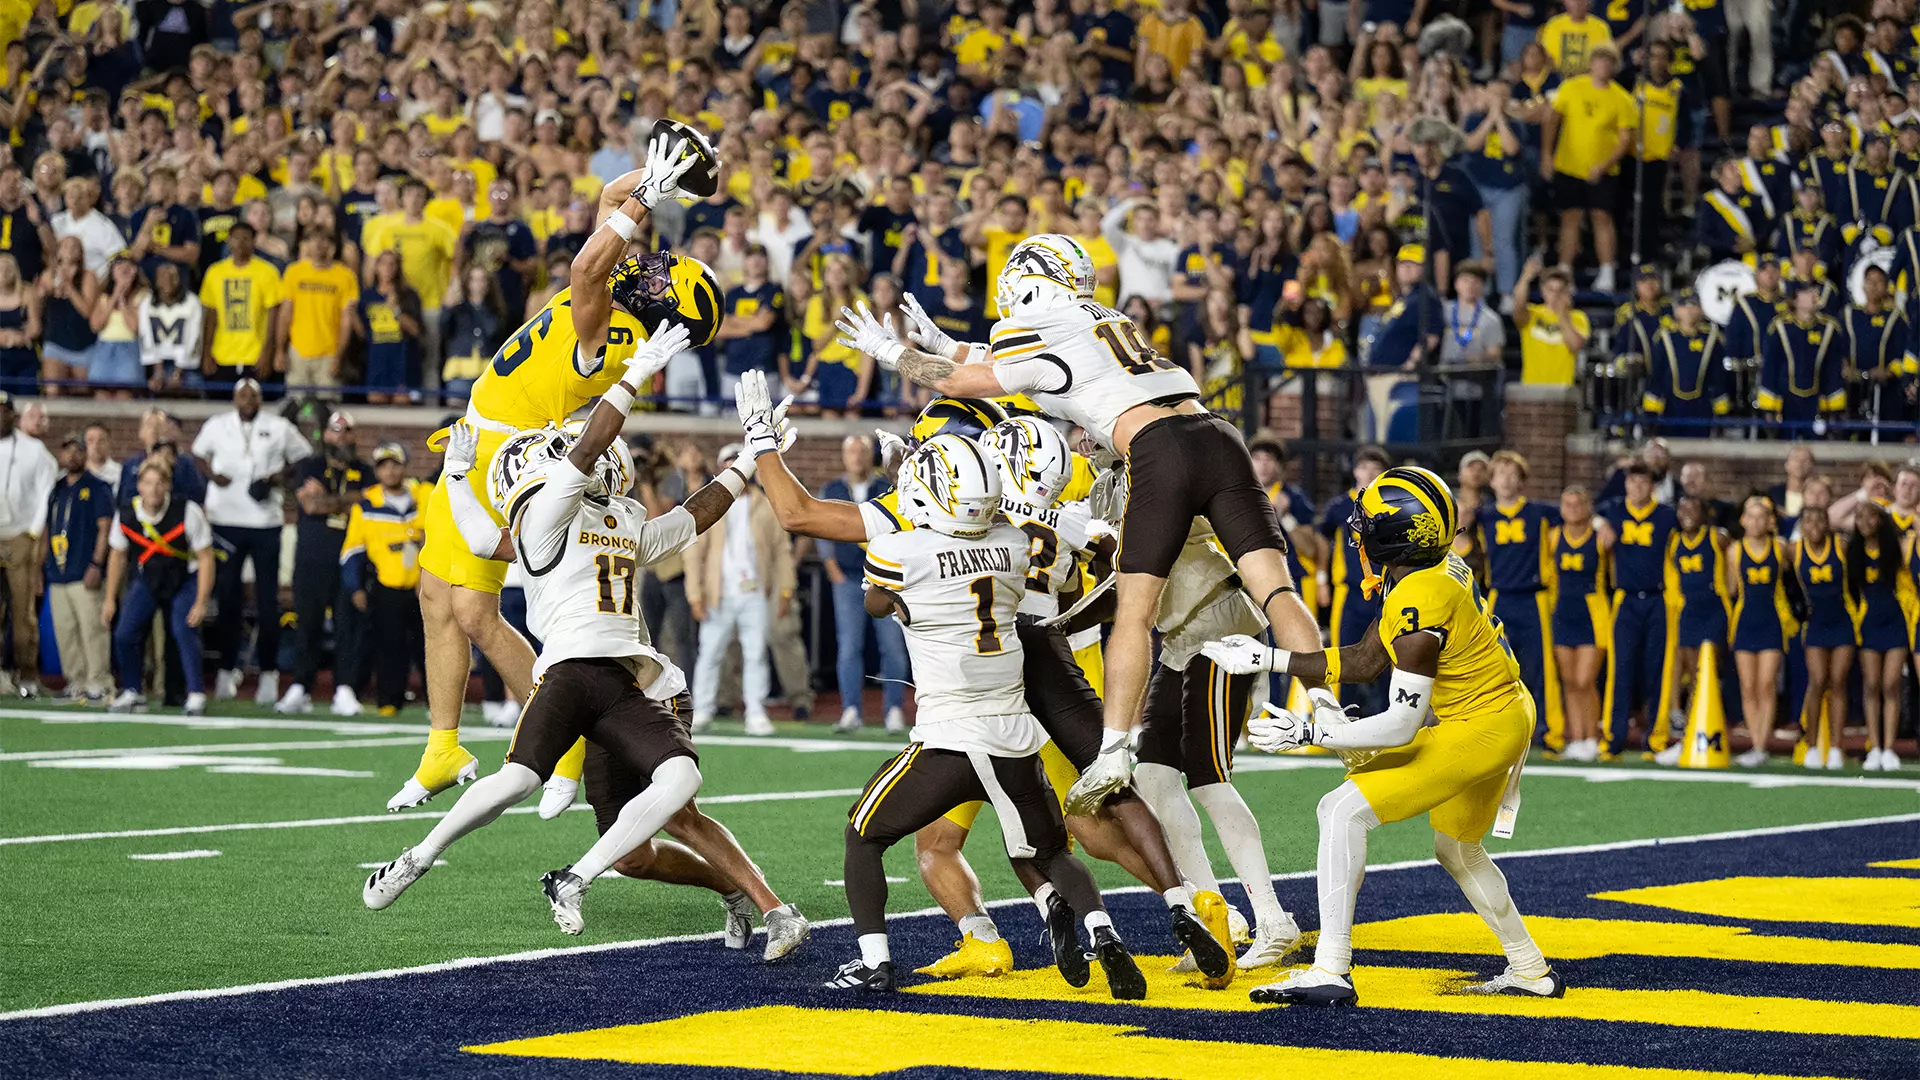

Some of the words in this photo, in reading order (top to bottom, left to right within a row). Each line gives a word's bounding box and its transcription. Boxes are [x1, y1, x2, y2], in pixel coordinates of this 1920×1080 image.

[149, 316, 184, 344] M
[493, 307, 553, 376] 6
[608, 326, 633, 345] 6
[1495, 518, 1527, 544] M
[1620, 518, 1655, 546] M
[936, 547, 1011, 579] FRANKLIN
[1560, 552, 1585, 572] M
[1678, 553, 1703, 573] M
[1810, 564, 1833, 584] M
[594, 552, 635, 616] 17
[1747, 566, 1771, 585] M
[969, 574, 1003, 654] 1
[1401, 606, 1420, 634] 3
[1252, 653, 1261, 666] M
[1395, 687, 1422, 709] M
[1697, 731, 1721, 753] M
